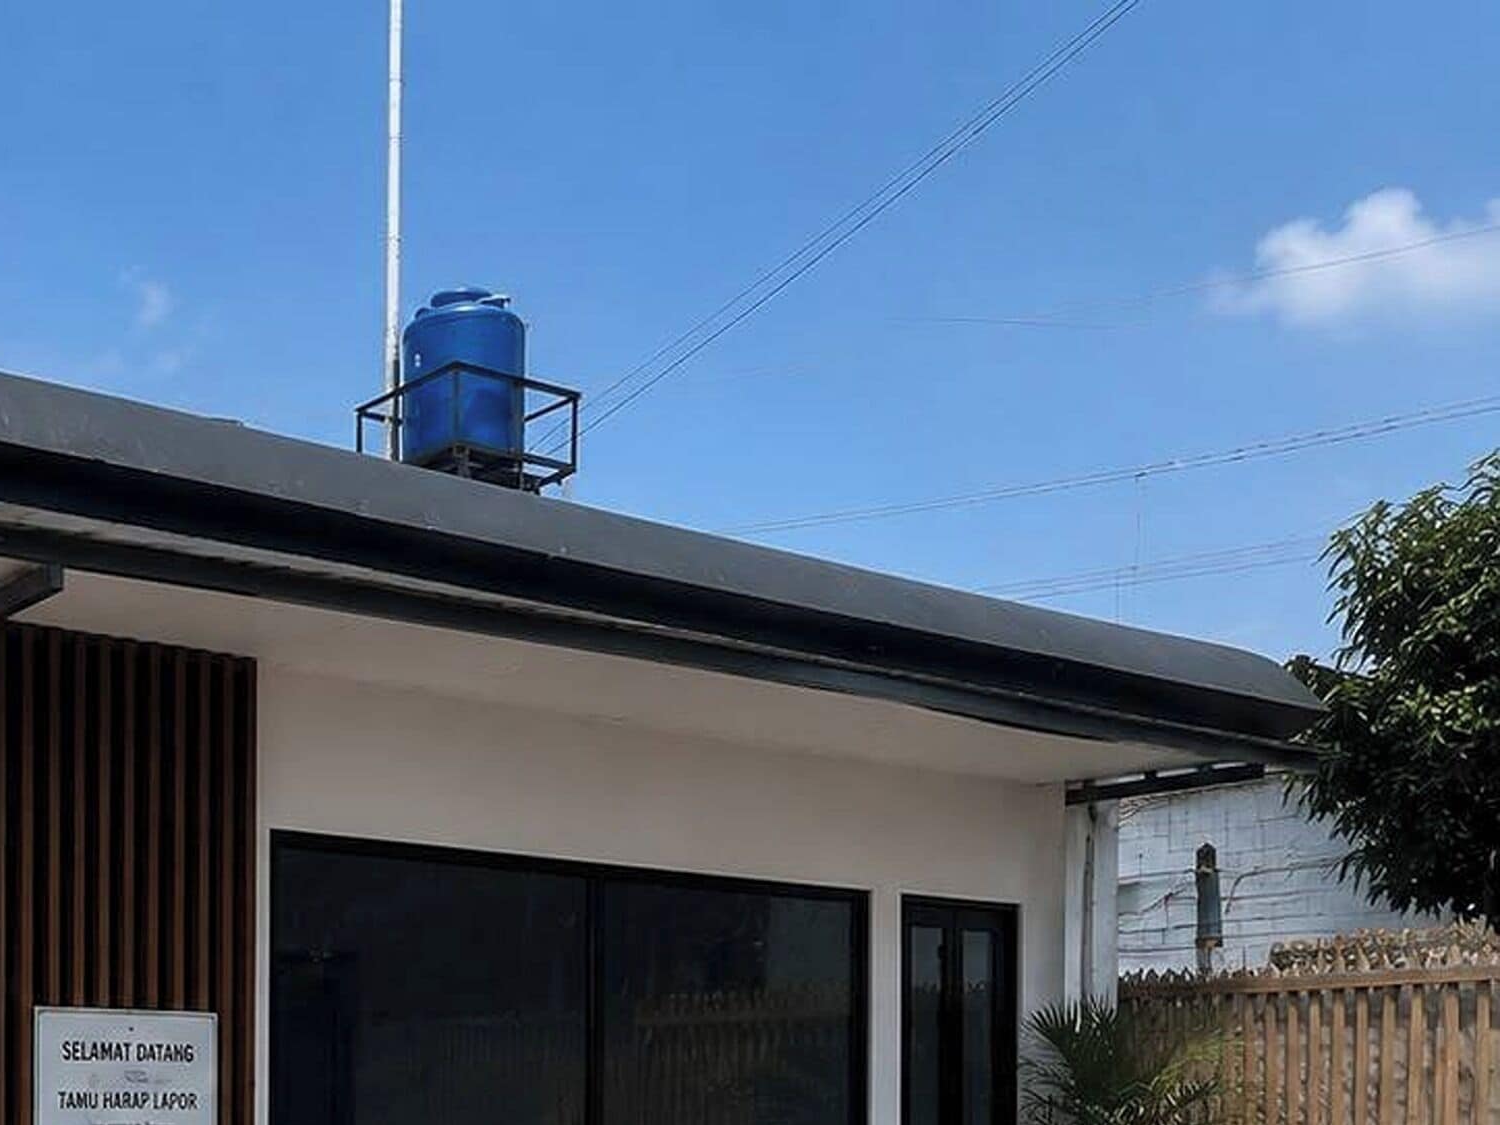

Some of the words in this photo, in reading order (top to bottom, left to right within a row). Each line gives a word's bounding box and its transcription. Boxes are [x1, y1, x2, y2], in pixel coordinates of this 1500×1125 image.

[62, 1041, 132, 1061] SELAMAT
[136, 1043, 194, 1063] DATANG
[58, 1091, 98, 1110] TAMU
[103, 1092, 149, 1110] HARAP
[153, 1092, 198, 1110] LAPOR
